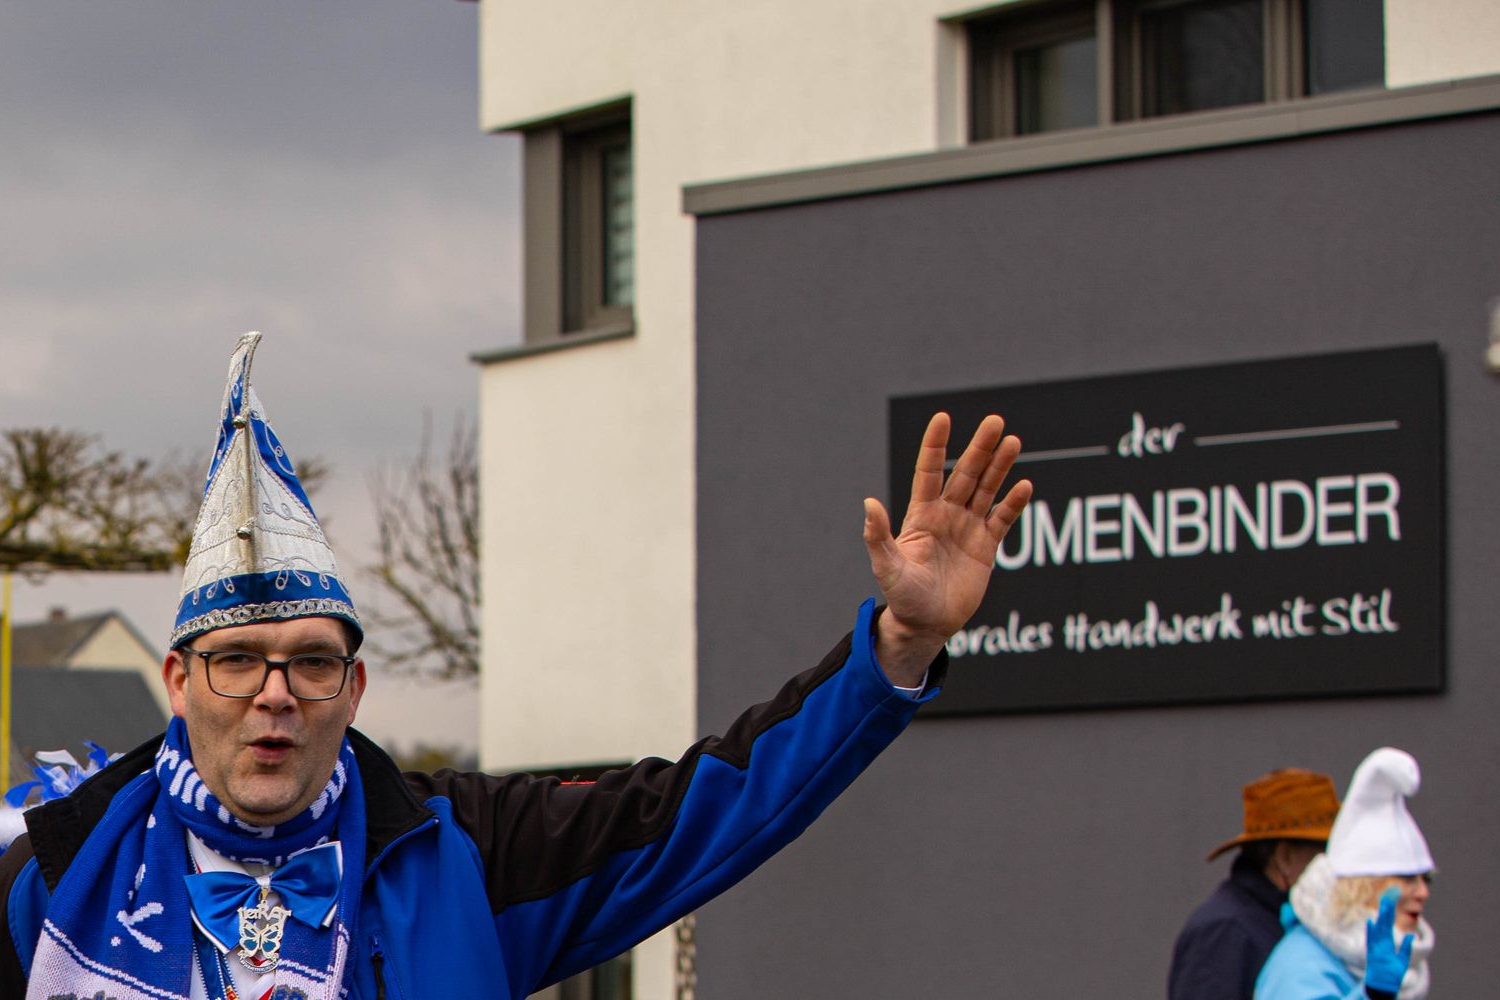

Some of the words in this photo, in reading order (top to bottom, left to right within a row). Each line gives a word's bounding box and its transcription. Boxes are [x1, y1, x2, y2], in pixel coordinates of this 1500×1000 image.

[1117, 411, 1186, 458] der
[994, 472, 1401, 571] UMENBINDER
[945, 608, 1054, 658] orales
[1064, 592, 1243, 652] Handwerk
[1252, 596, 1316, 639] mit
[1321, 587, 1400, 636] Stil
